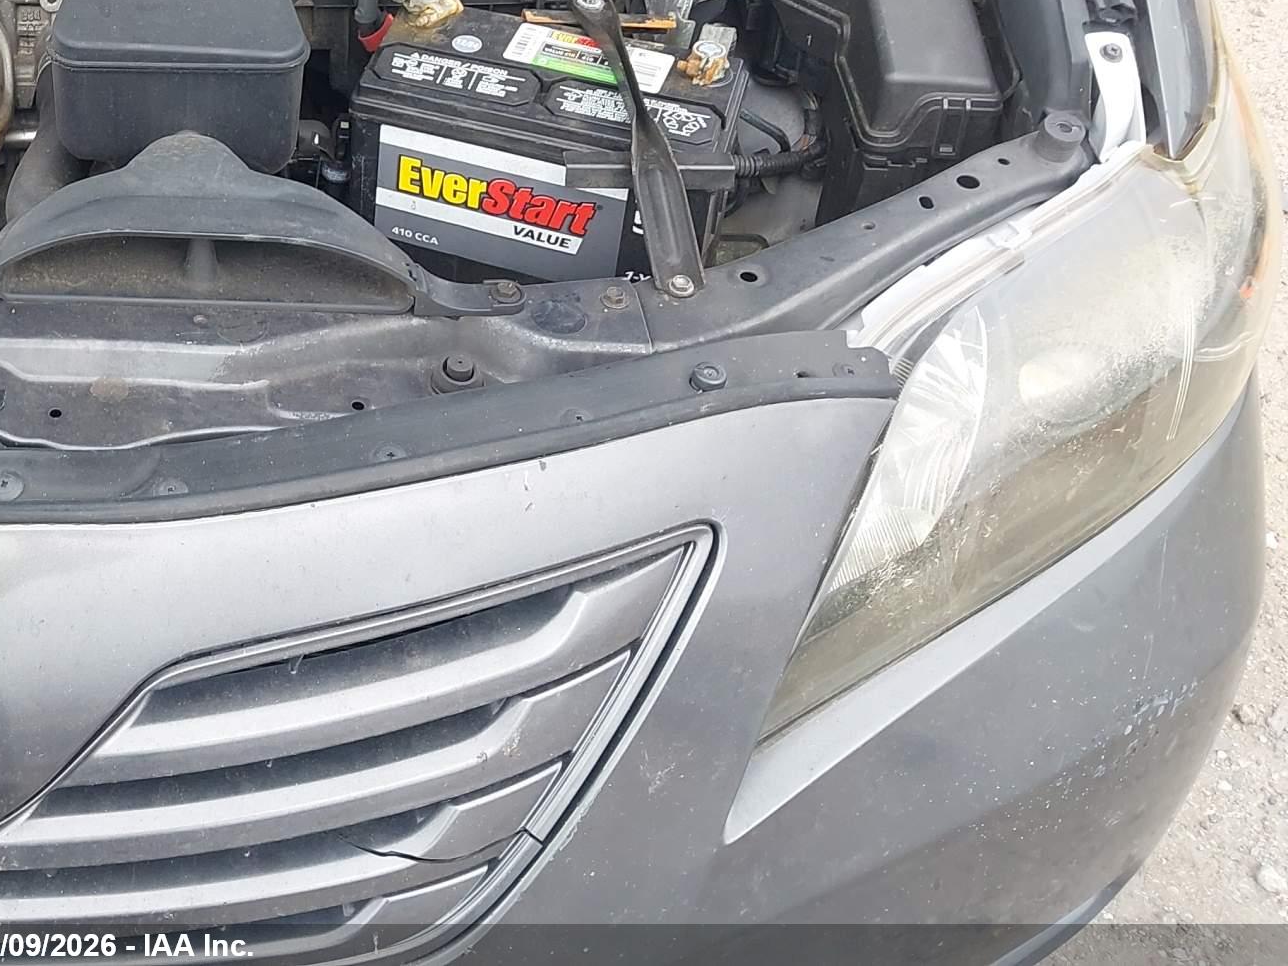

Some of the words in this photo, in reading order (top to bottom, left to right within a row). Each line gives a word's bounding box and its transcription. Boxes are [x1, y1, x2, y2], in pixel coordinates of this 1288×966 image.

[396, 154, 596, 236] EverStart
[391, 225, 413, 239] 410
[415, 231, 440, 246] CCA
[513, 225, 572, 249] VALUE
